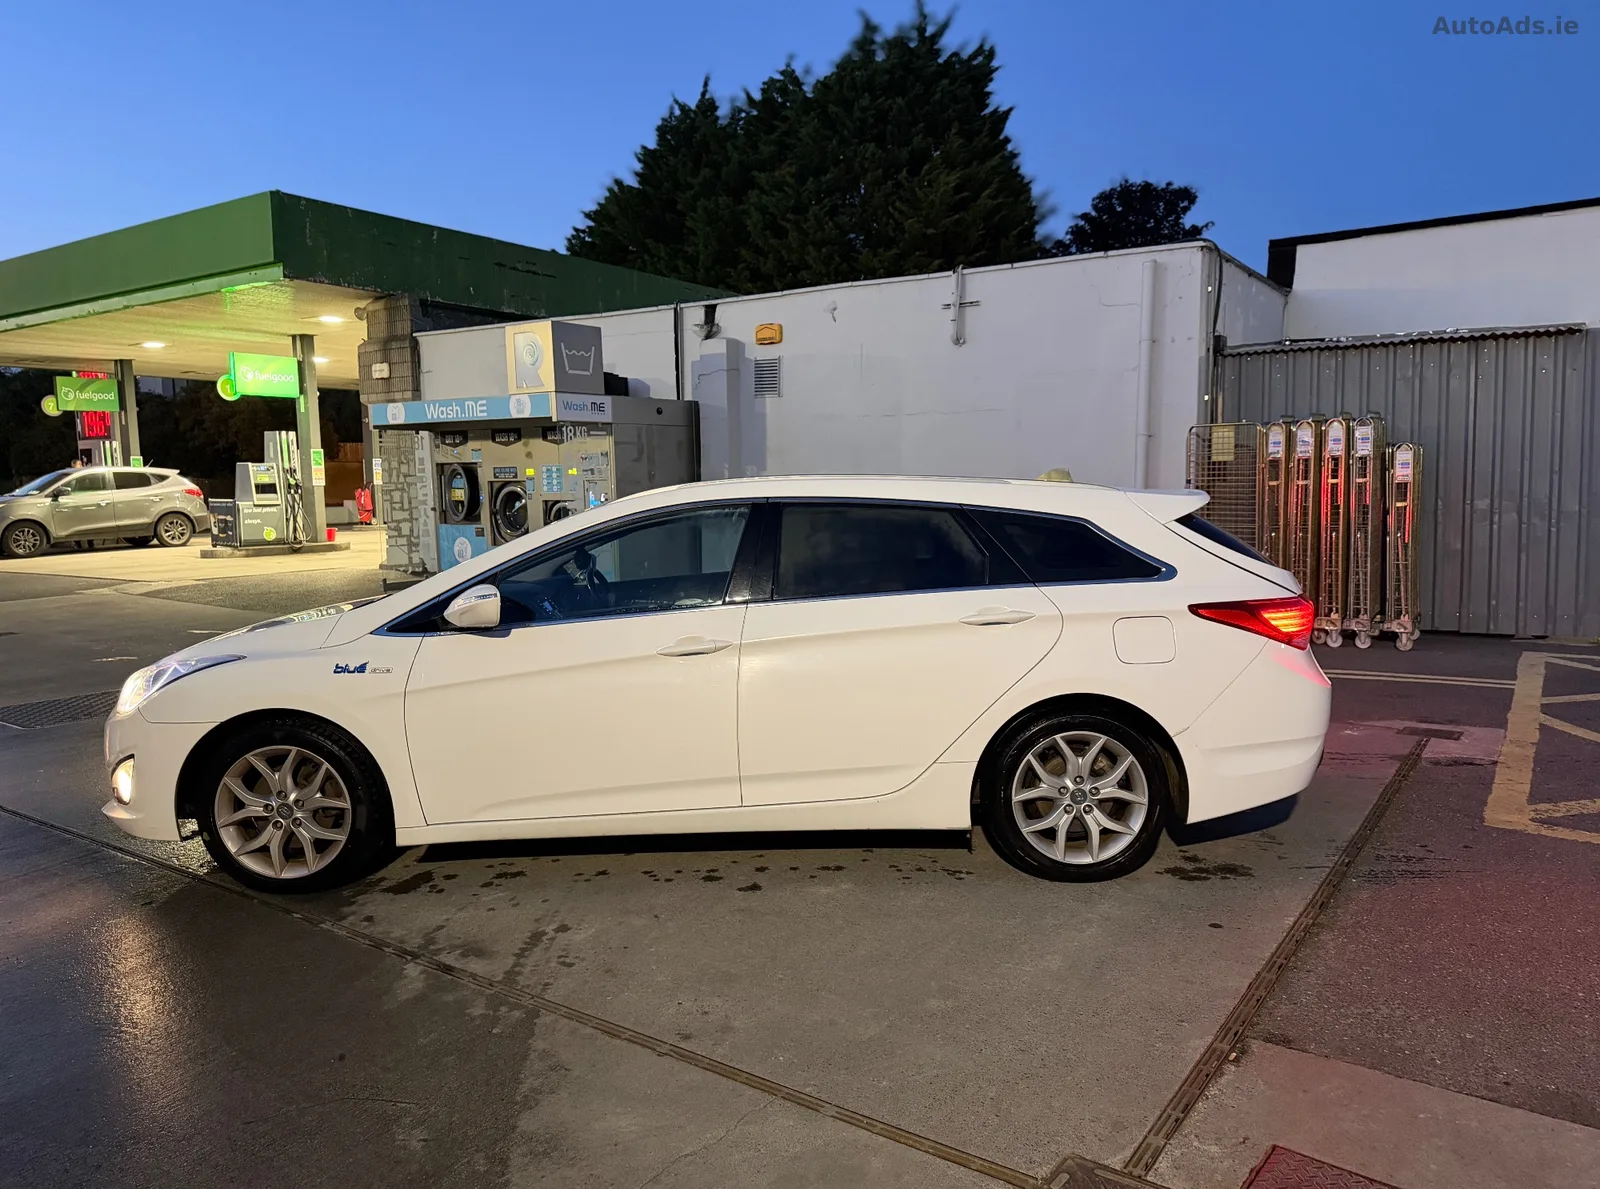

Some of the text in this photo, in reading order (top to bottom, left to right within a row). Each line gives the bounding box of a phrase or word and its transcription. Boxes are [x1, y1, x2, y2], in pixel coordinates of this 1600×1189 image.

[254, 370, 294, 383] fuelgood
[225, 384, 231, 394] 1
[75, 390, 115, 401] fuelgood
[48, 402, 54, 411] 7
[424, 400, 488, 419] Wash.ME
[562, 400, 605, 412] Wash.ME
[494, 432, 508, 442] WASH
[562, 425, 588, 443] 18 KG
[333, 660, 369, 674] blue
